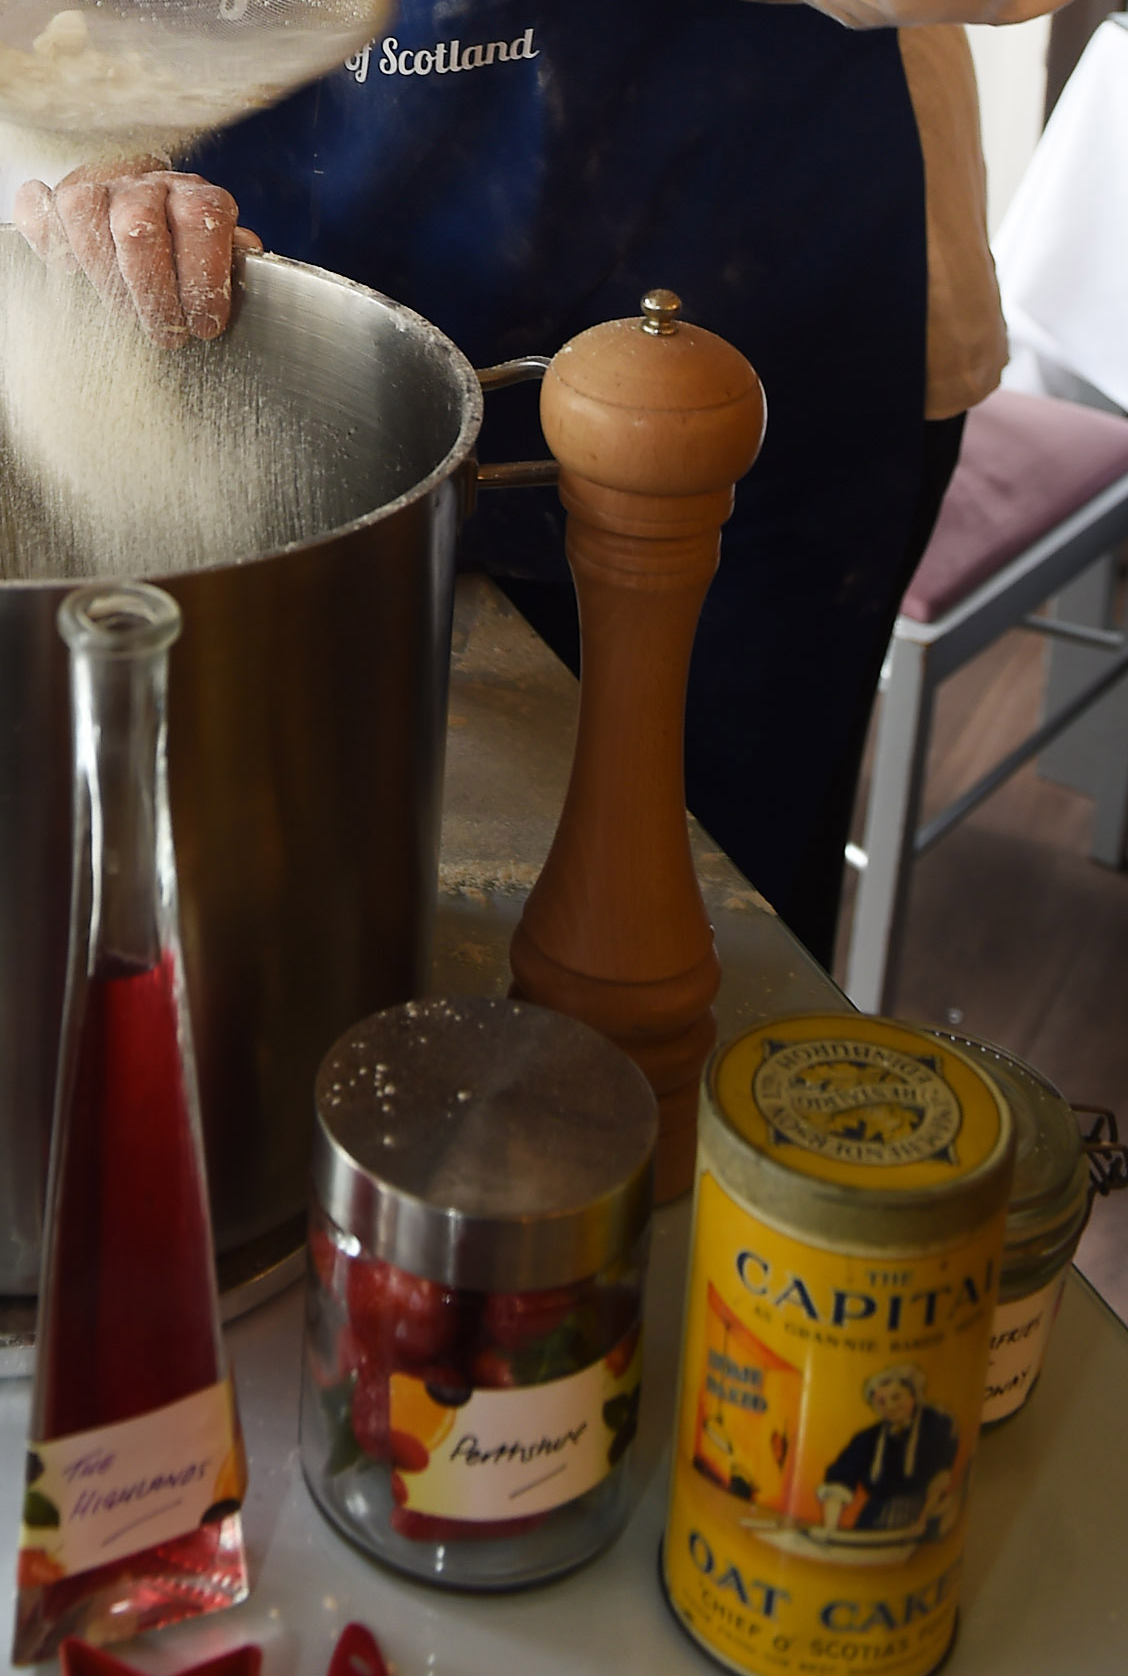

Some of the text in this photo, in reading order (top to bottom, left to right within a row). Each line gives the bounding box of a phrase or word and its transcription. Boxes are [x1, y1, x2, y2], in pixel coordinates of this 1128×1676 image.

[344, 28, 540, 84] of Scotland
[688, 1530, 791, 1618] OAT
